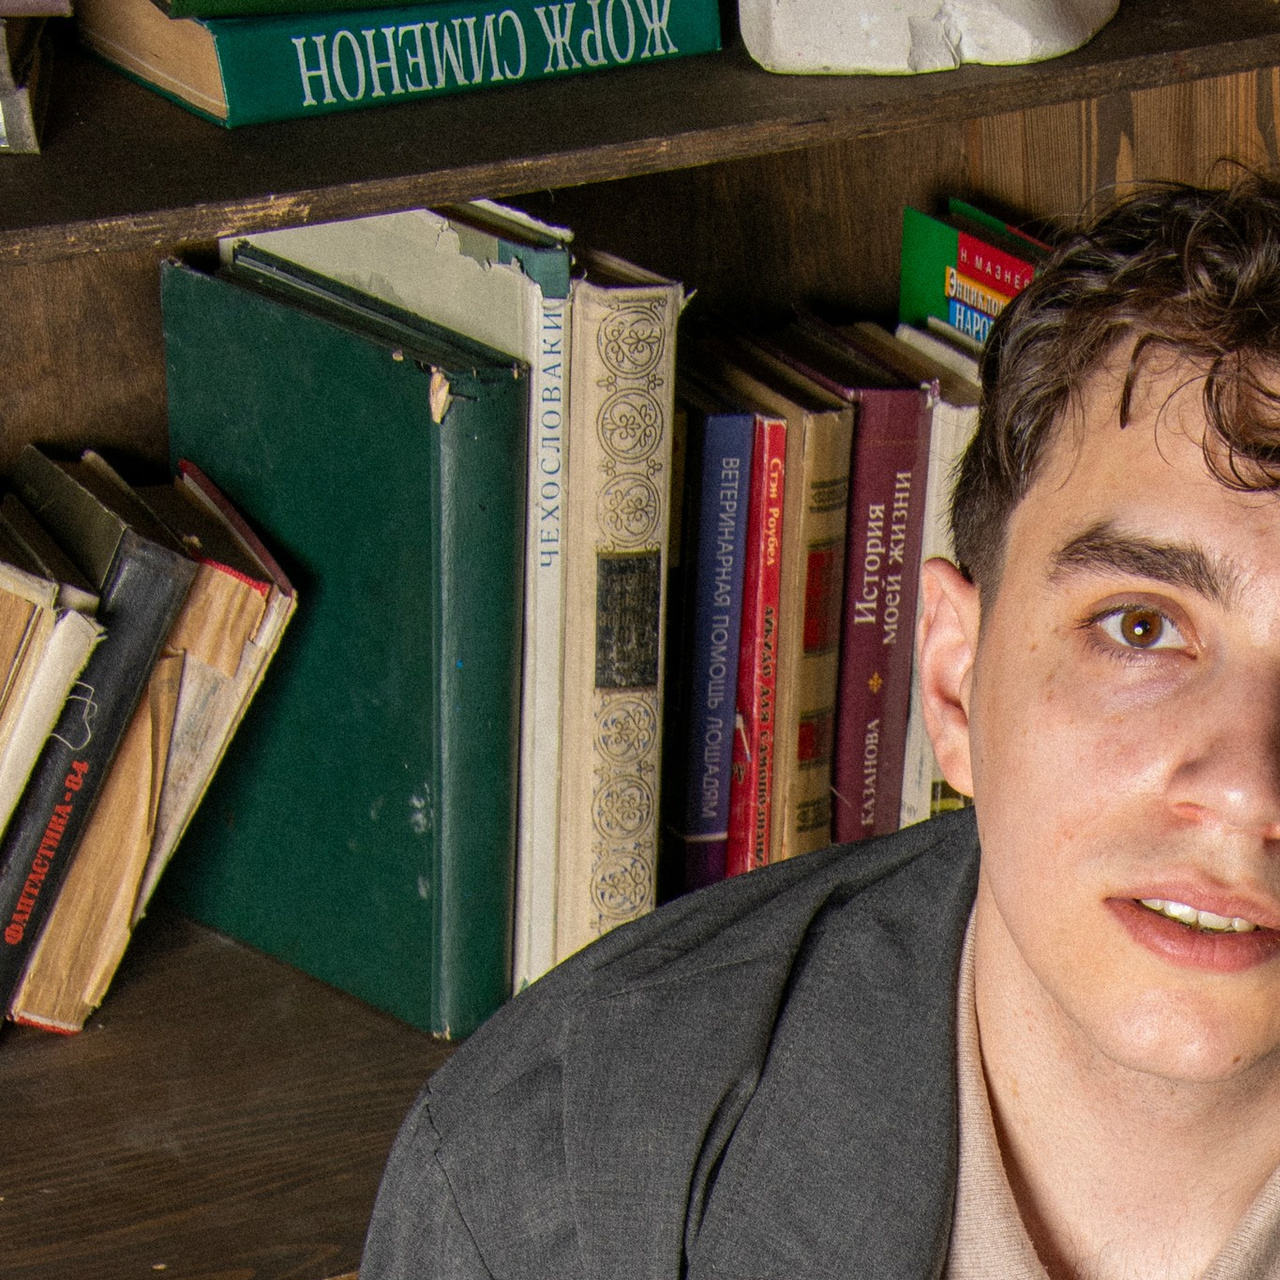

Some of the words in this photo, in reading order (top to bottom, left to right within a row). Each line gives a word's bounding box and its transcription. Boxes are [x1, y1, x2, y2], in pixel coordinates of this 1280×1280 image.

[291, 9, 527, 106] СИМЕНОН
[535, 0, 678, 73] ЖОРЖ
[540, 312, 563, 568] ЧЕХОСЛОВАКИ
[767, 457, 782, 499] Стэн
[713, 457, 740, 607] ВЕТЕРИНАРНАЯ
[766, 506, 780, 567] Роубел
[854, 503, 886, 625] История
[889, 471, 912, 565] жизни
[882, 575, 902, 646] моей
[707, 615, 730, 710] ПОМОЩЬ
[701, 716, 723, 819] ЛОШАДЯМ
[755, 730, 771, 868] САМОПОЗНАНИ
[861, 718, 880, 827] КАЗАНОВА
